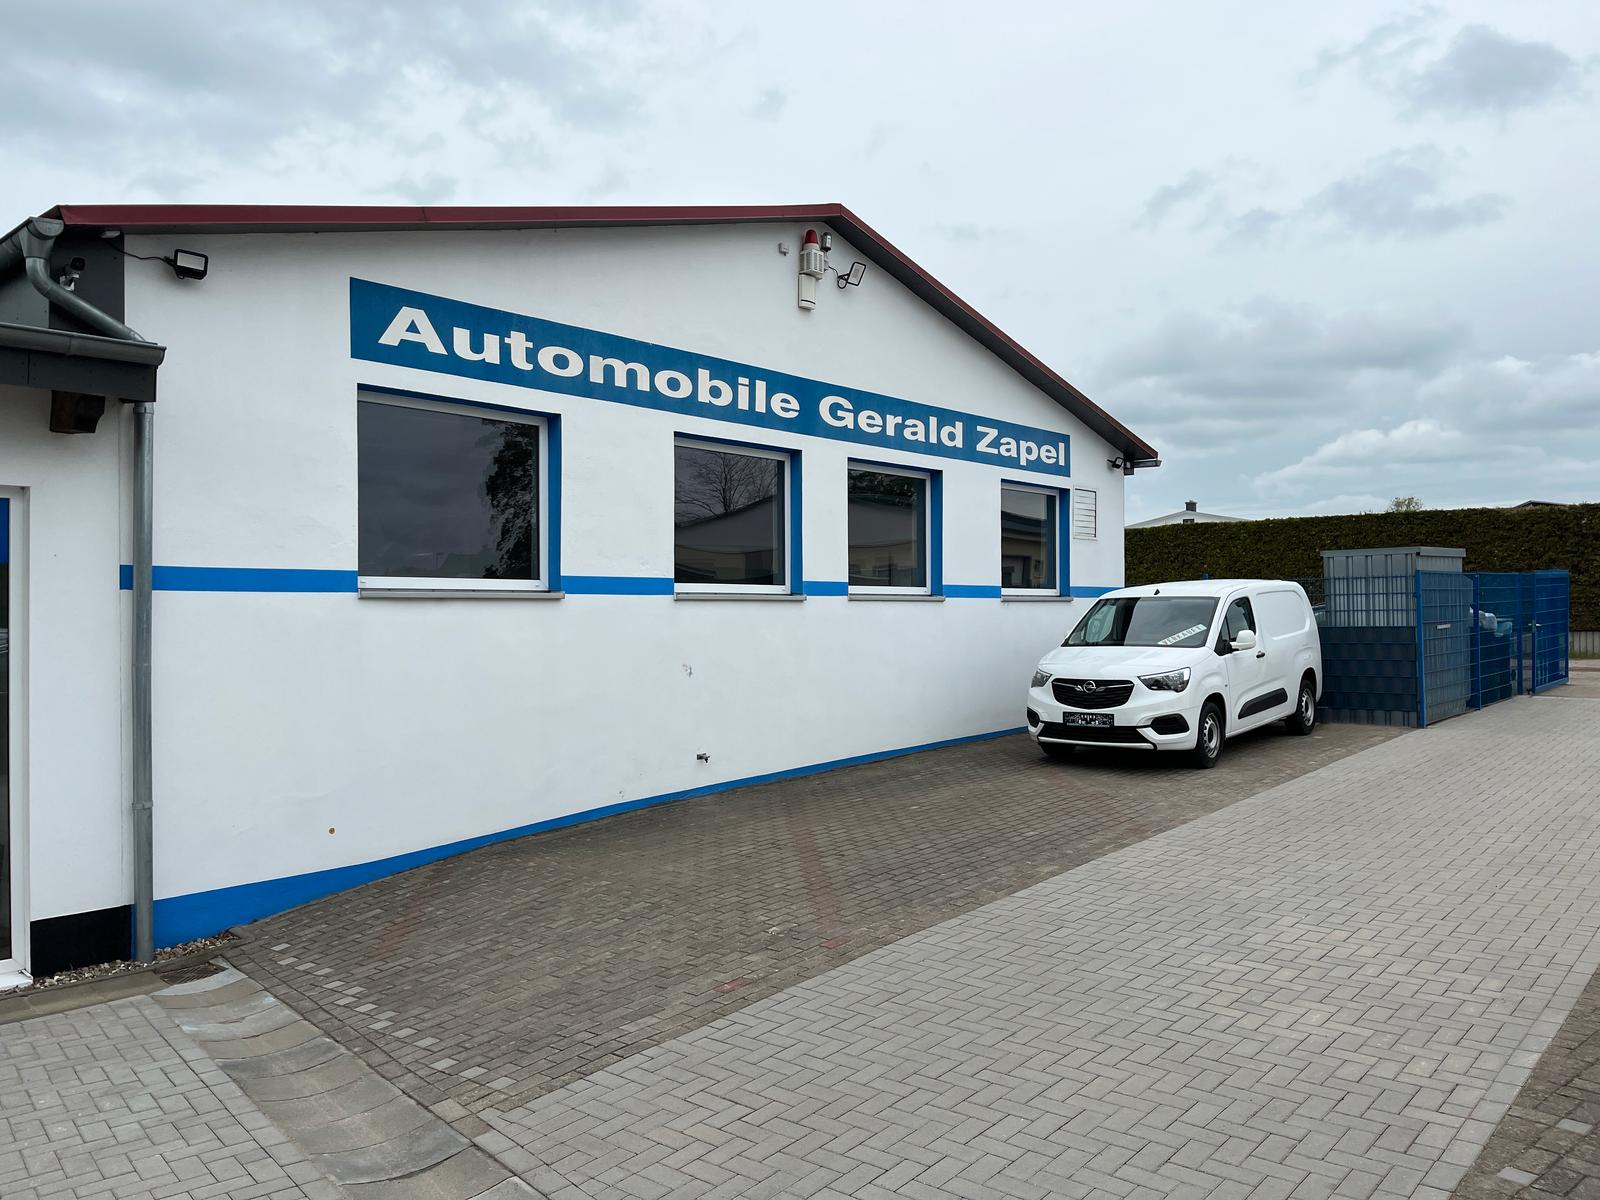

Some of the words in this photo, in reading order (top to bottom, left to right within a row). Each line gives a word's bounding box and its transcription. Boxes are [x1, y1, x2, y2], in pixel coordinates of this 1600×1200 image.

[378, 306, 800, 418] Automobile
[818, 395, 963, 448] Gerald
[976, 425, 1066, 466] Zapel
